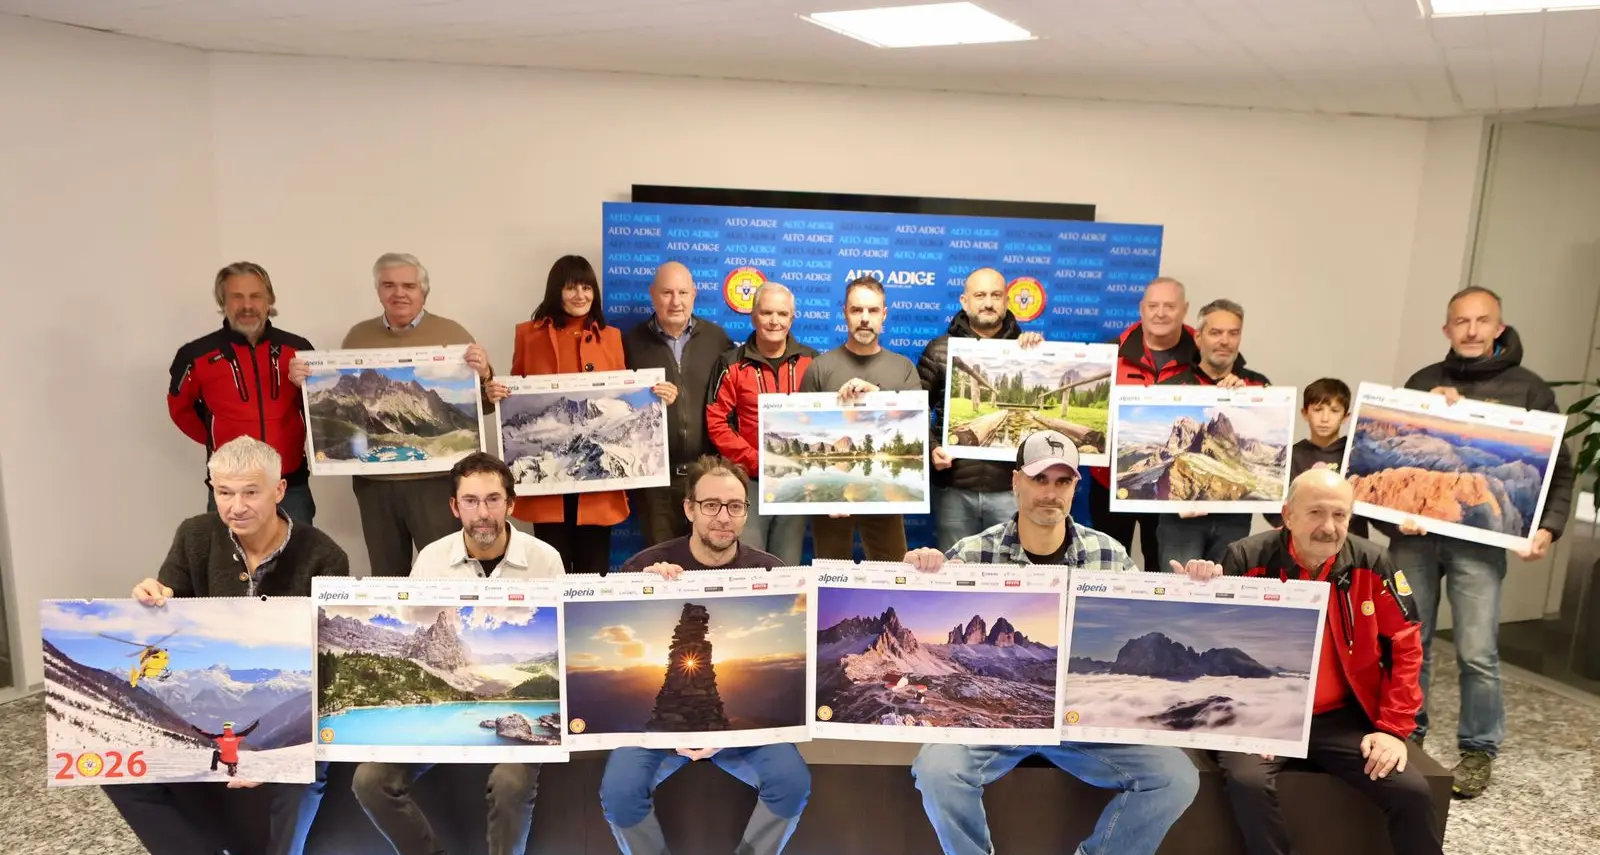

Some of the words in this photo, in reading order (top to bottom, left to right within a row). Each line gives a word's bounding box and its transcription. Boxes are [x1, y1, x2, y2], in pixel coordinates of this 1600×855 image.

[725, 218, 748, 227] ALTO
[750, 219, 778, 228] ADIGE
[608, 227, 631, 235] ALTO
[632, 227, 661, 236] ADIGE
[896, 225, 916, 233] ALTO
[918, 226, 945, 235] ADIGE
[782, 233, 804, 242] ALTO
[806, 234, 834, 243] ADIGE
[1058, 232, 1079, 241] ALTO
[1081, 234, 1107, 242] ADIGE
[667, 242, 690, 251] ALTO
[691, 243, 720, 252] ADIGE
[949, 241, 971, 249] ALTO
[972, 242, 999, 250] ADIGE
[838, 249, 860, 257] ALTO
[862, 249, 889, 258] ADIGE
[1110, 247, 1131, 255] ALTO
[1134, 248, 1157, 256] ADIGE
[724, 257, 747, 266] ALTO
[748, 258, 777, 267] ADIGE
[1003, 255, 1024, 264] ALTO
[1026, 257, 1051, 265] ADIGE
[608, 266, 631, 275] ALTO
[1055, 270, 1076, 278] ALTO
[1077, 271, 1103, 280] ADIGE
[781, 271, 803, 280] ALTO
[805, 272, 832, 281] ADIGE
[887, 271, 936, 286] ADIGE
[1106, 284, 1127, 292] ALTO
[608, 305, 630, 313] ALTO
[891, 301, 912, 309] ALTO
[914, 302, 941, 311] ADIGE
[803, 311, 831, 320] ADIGE
[1052, 307, 1073, 315] ALTO
[1075, 308, 1099, 316] ADIGE
[1103, 321, 1123, 329] ALTO
[889, 339, 910, 347] ALTO
[818, 574, 848, 584] alperia
[1076, 583, 1107, 593] alperia
[318, 591, 350, 601] alperia
[563, 588, 595, 599] alperia
[55, 750, 147, 779] 2026
